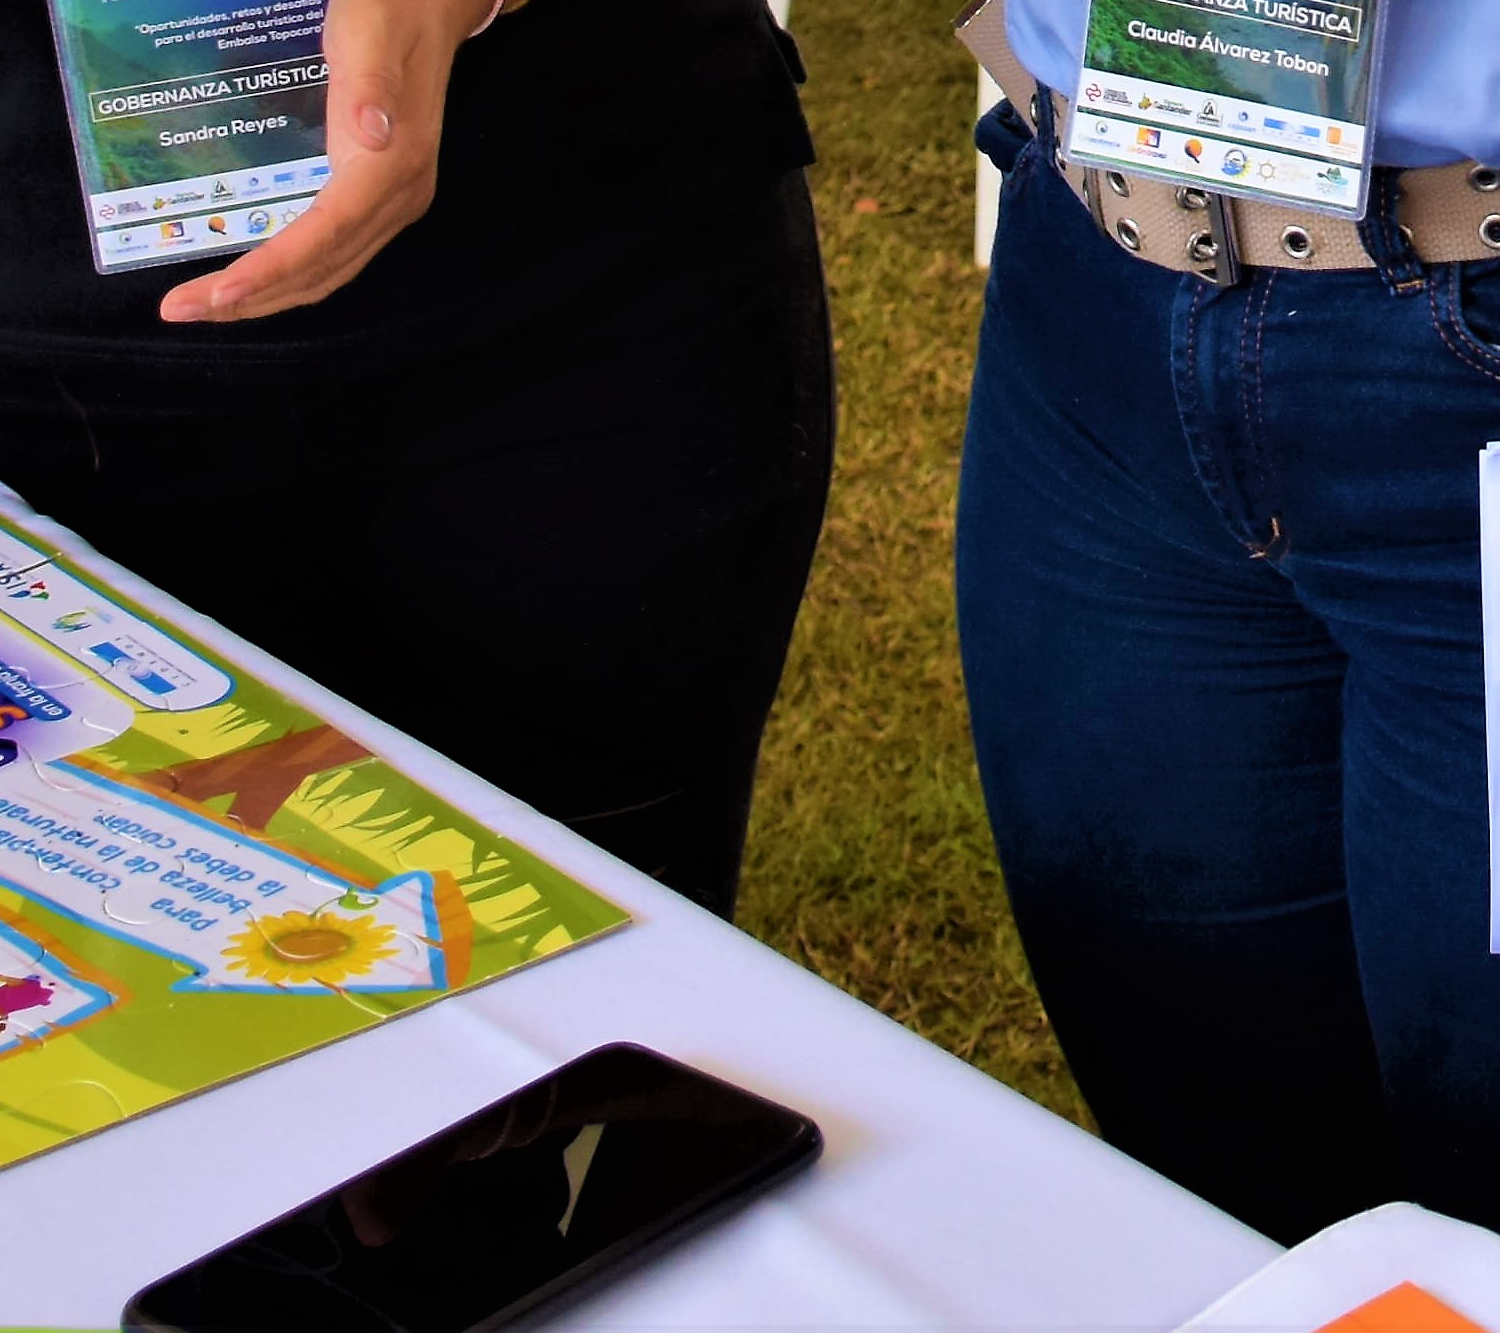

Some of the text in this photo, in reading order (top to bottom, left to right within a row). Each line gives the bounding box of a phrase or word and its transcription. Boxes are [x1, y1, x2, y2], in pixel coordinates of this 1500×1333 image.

[155, 35, 184, 48] para
[184, 30, 196, 41] el
[197, 21, 256, 40] desarrollo
[306, 9, 324, 20] del
[231, 8, 262, 20] retos
[263, 4, 271, 16] y
[217, 34, 268, 51] Embalse
[1127, 19, 1329, 77] Claudia Álvarez Tobon
[98, 63, 330, 117] GOBERNANZA TURÍSTICA
[159, 114, 288, 149] Sandra Reyes
[98, 841, 125, 866] la
[123, 848, 159, 876] de
[177, 845, 256, 886] debes
[156, 859, 252, 915] belleza
[259, 878, 288, 899] la
